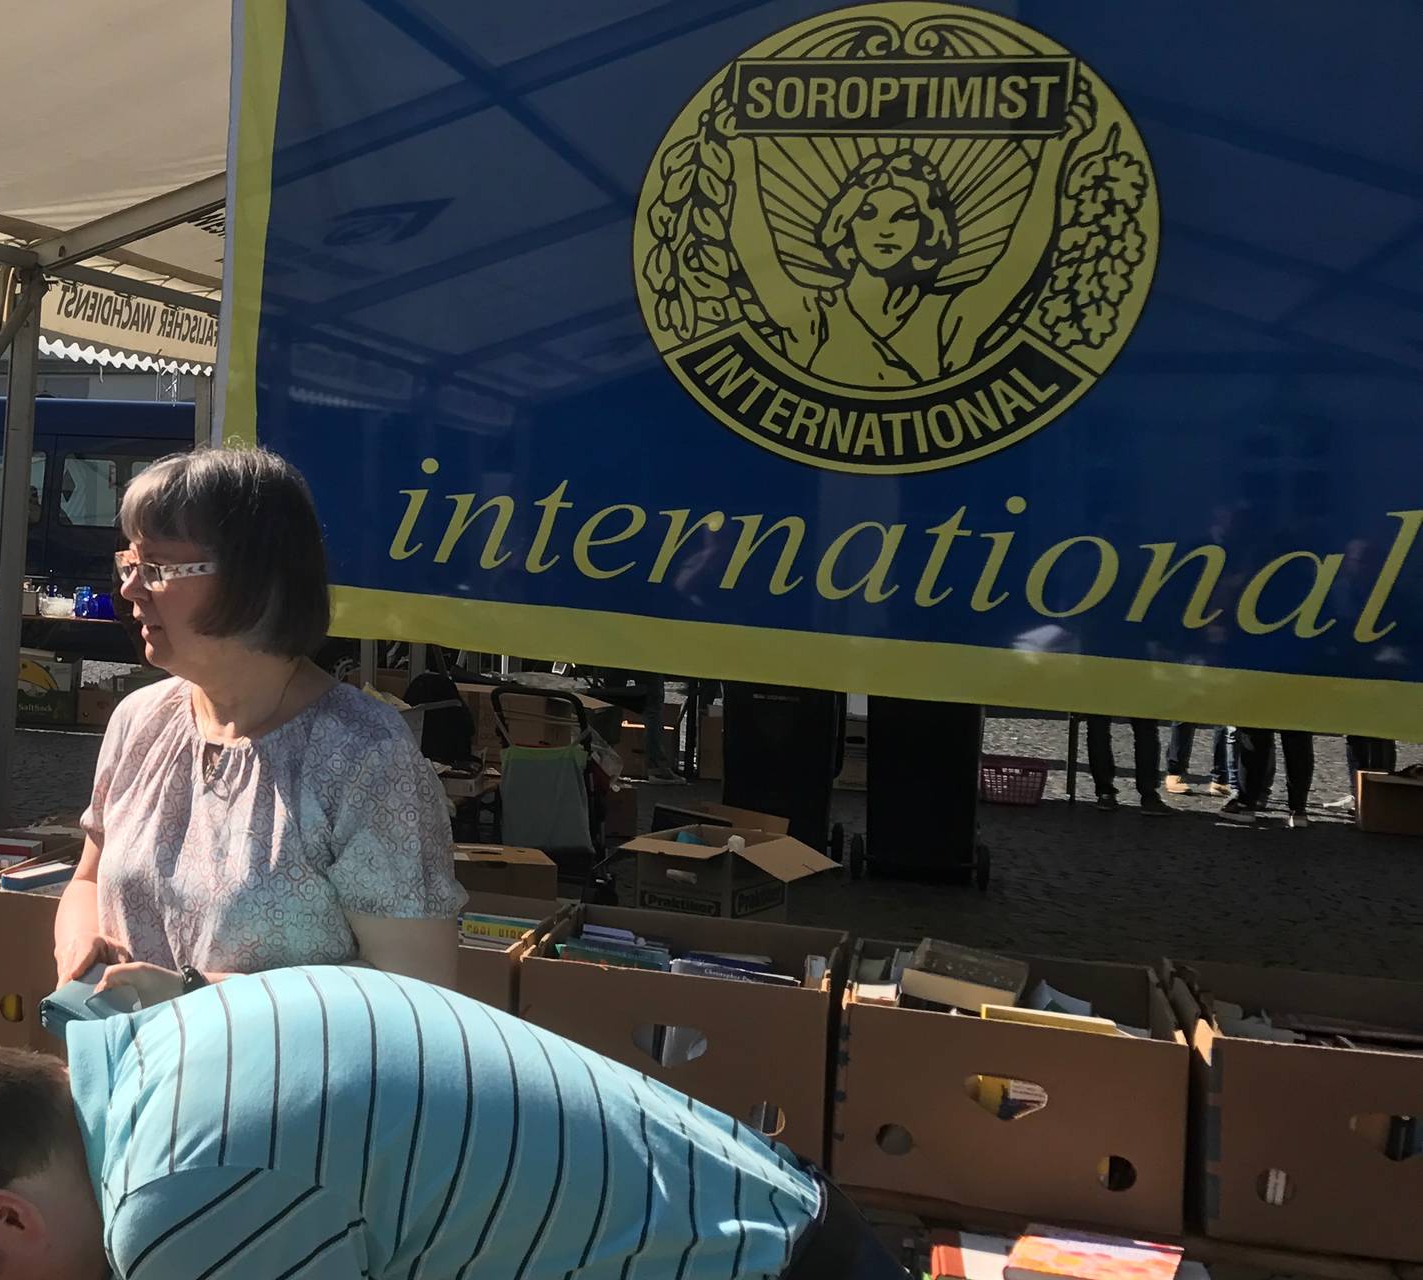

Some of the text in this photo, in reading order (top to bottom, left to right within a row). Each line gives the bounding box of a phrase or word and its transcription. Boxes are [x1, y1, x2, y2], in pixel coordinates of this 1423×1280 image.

[745, 75, 1061, 120] SOROPTIMIST
[693, 344, 1060, 456] INTERNATIONAL
[388, 457, 1423, 643] international
